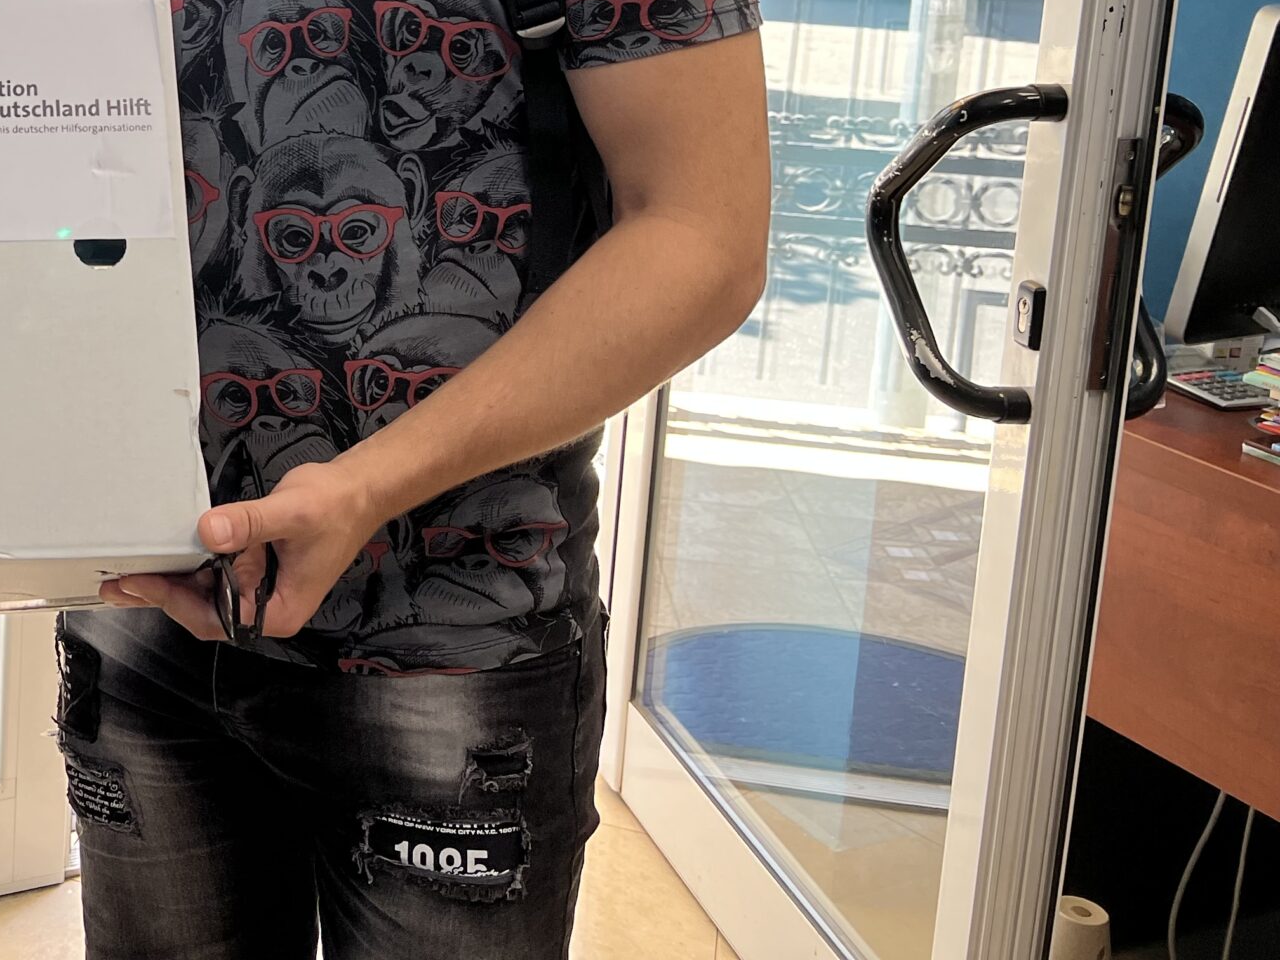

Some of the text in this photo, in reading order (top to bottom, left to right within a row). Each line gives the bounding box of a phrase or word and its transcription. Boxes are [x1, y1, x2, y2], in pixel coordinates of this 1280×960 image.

[106, 97, 152, 117] Hilft
[12, 124, 59, 134] deutscher
[61, 123, 152, 135] Hilfsorganisationen
